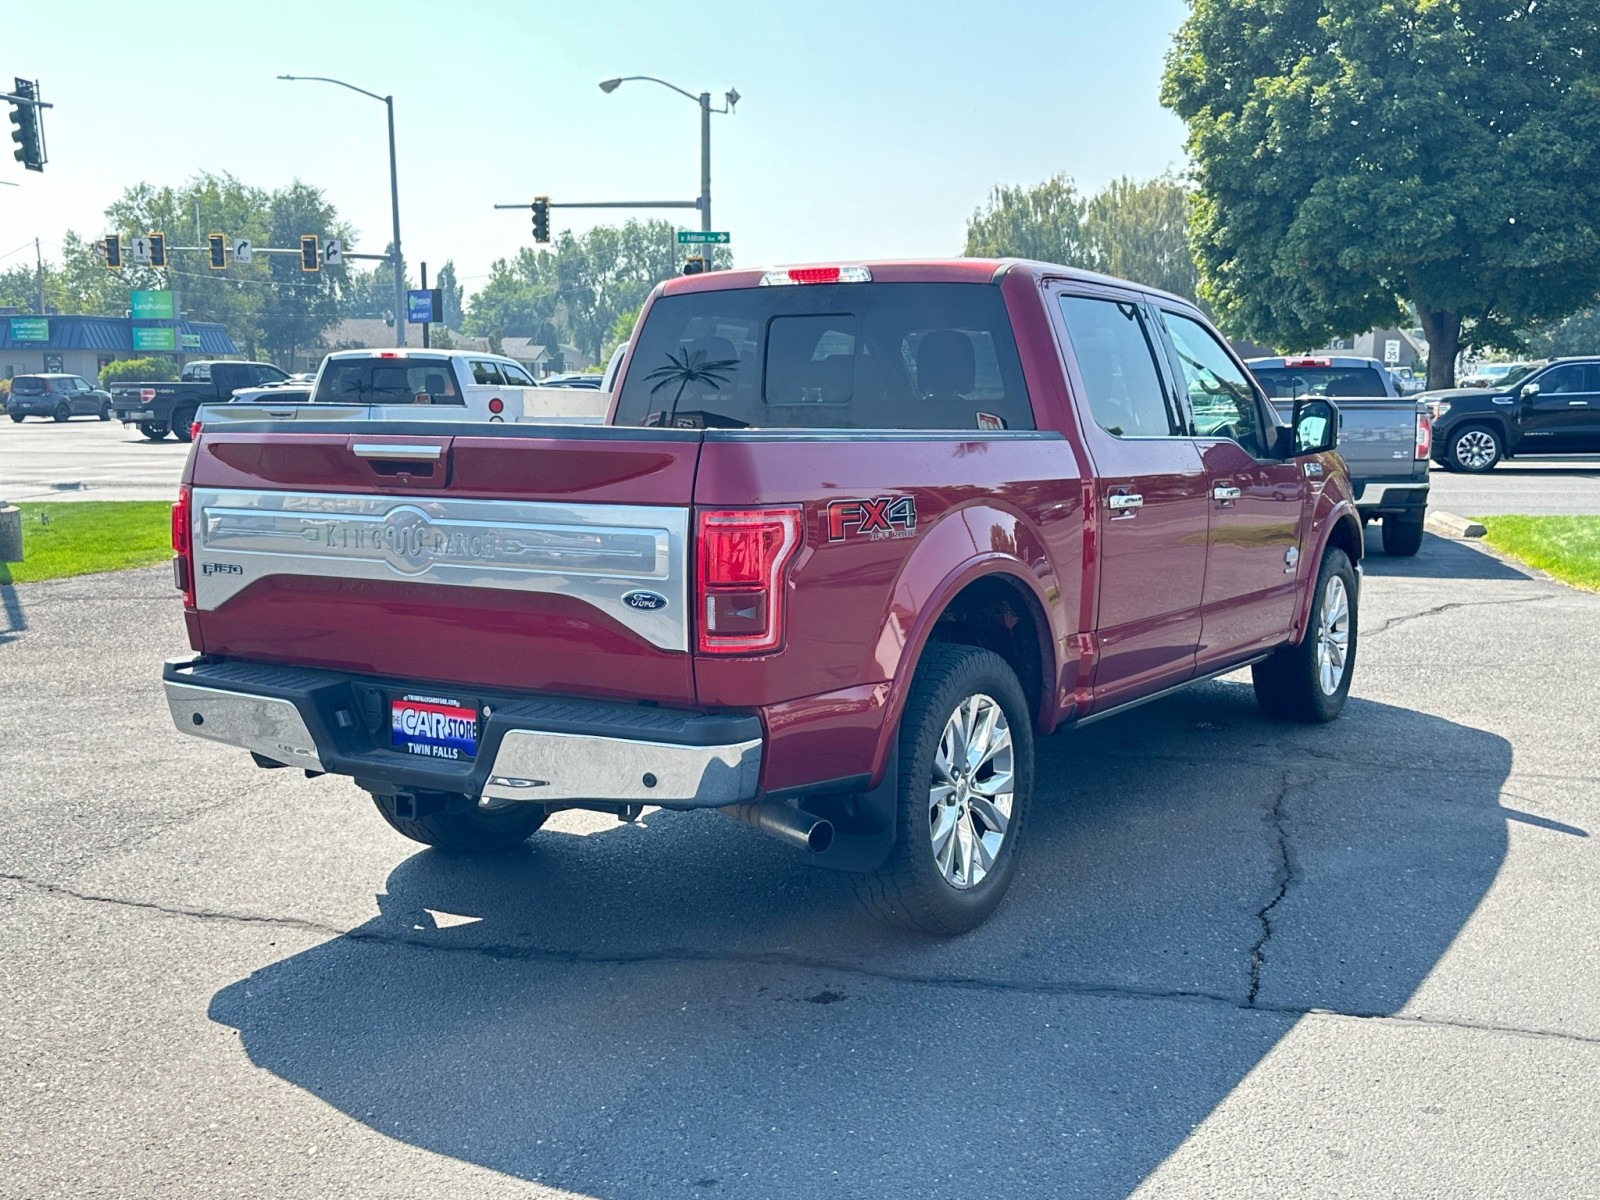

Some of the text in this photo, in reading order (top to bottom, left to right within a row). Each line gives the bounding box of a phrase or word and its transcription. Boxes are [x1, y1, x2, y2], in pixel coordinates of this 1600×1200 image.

[1387, 352, 1397, 360] 35
[827, 496, 917, 542] FX4
[326, 524, 496, 558] KING RANCH
[631, 594, 657, 607] Ford
[401, 708, 477, 740] CAR STORE
[408, 743, 458, 759] TWIN FALLS
